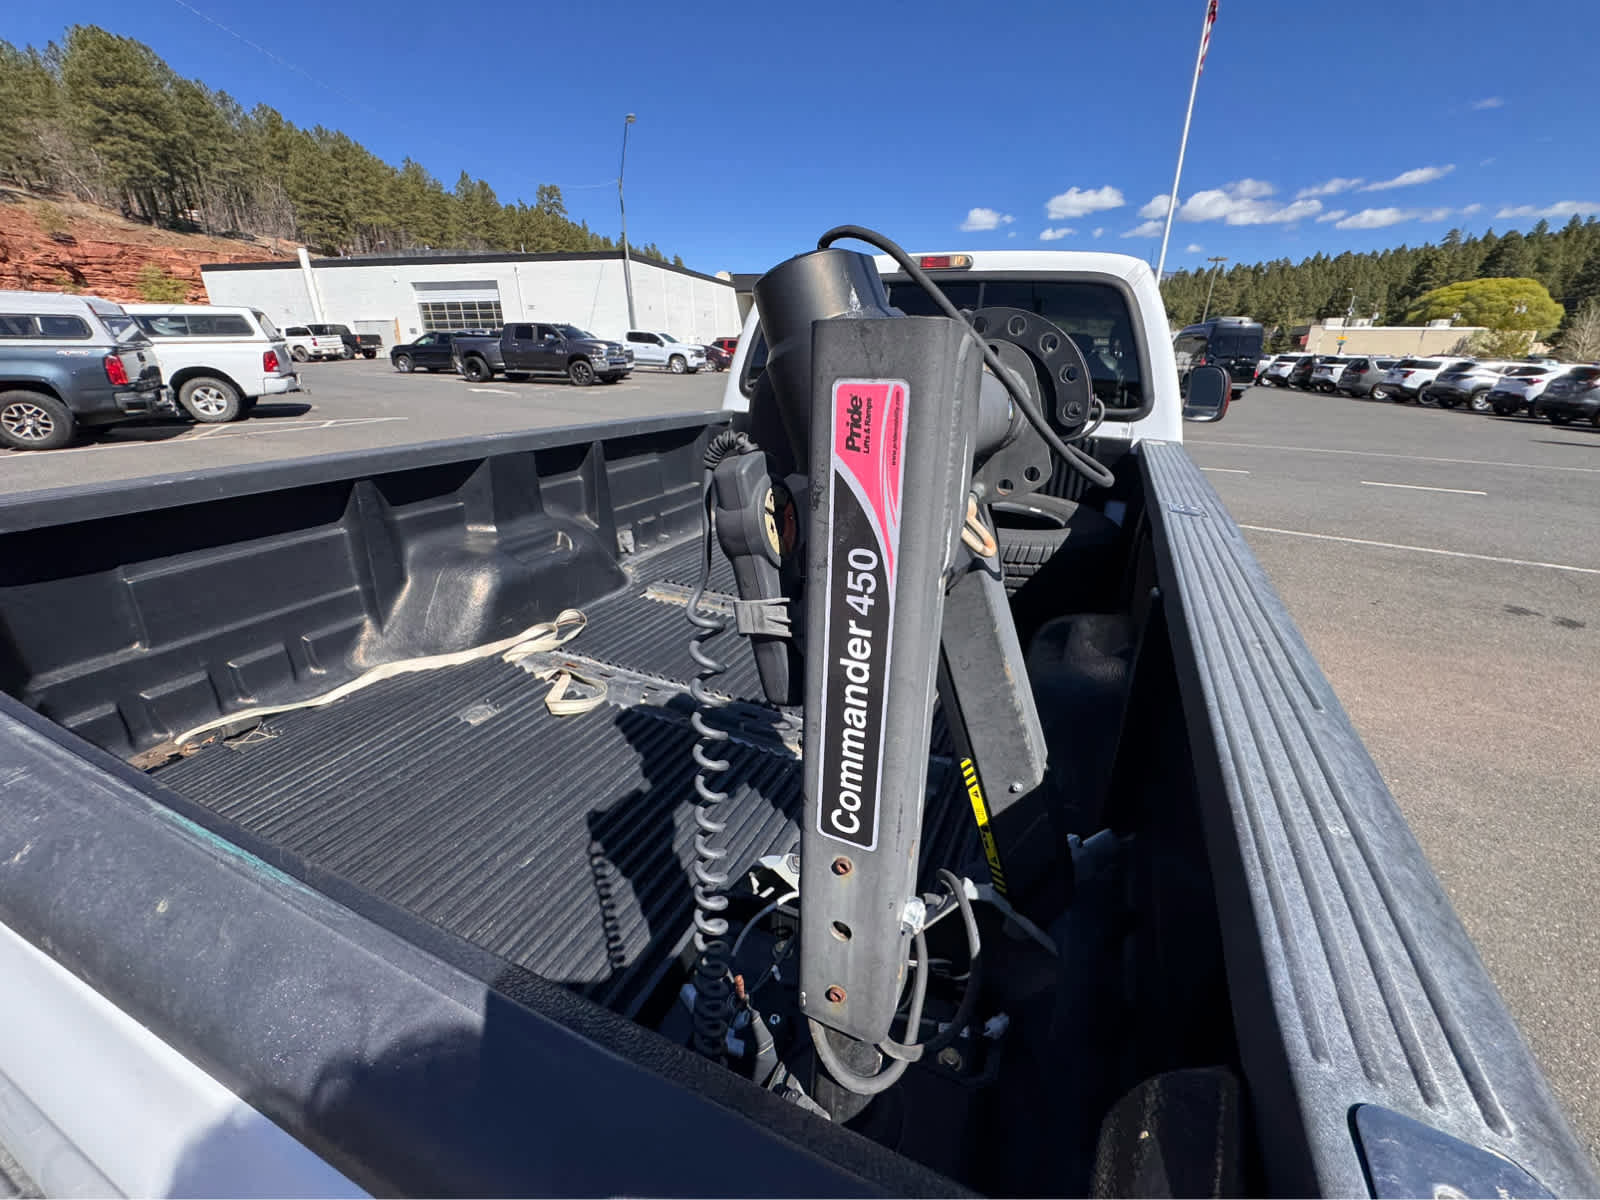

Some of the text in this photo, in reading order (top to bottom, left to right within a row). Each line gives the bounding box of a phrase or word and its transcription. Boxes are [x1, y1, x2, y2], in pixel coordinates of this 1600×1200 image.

[845, 395, 863, 453] Pride
[864, 397, 873, 426] Ramps
[863, 435, 871, 455] Lifts
[830, 548, 878, 835] Commander 450
